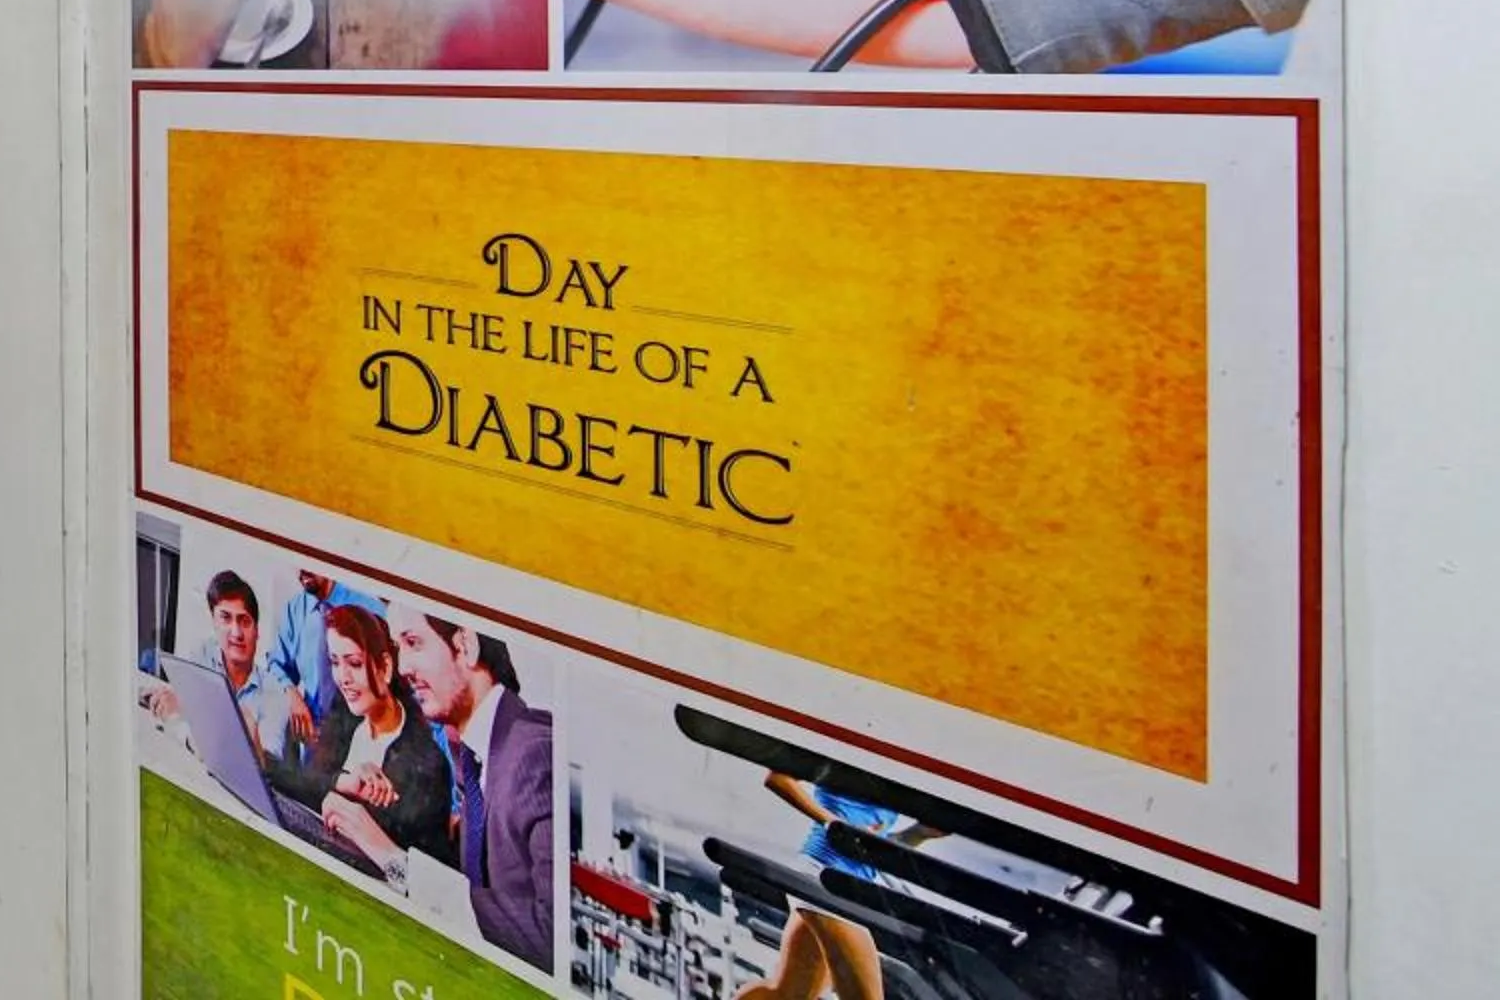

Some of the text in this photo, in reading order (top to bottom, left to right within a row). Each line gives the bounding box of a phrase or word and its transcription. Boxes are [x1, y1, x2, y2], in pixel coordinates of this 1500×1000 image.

[482, 233, 630, 311] DAY
[362, 295, 775, 403] IN THE LIFE OF A
[359, 349, 796, 526] DIABETIC
[283, 894, 363, 997] I'm
